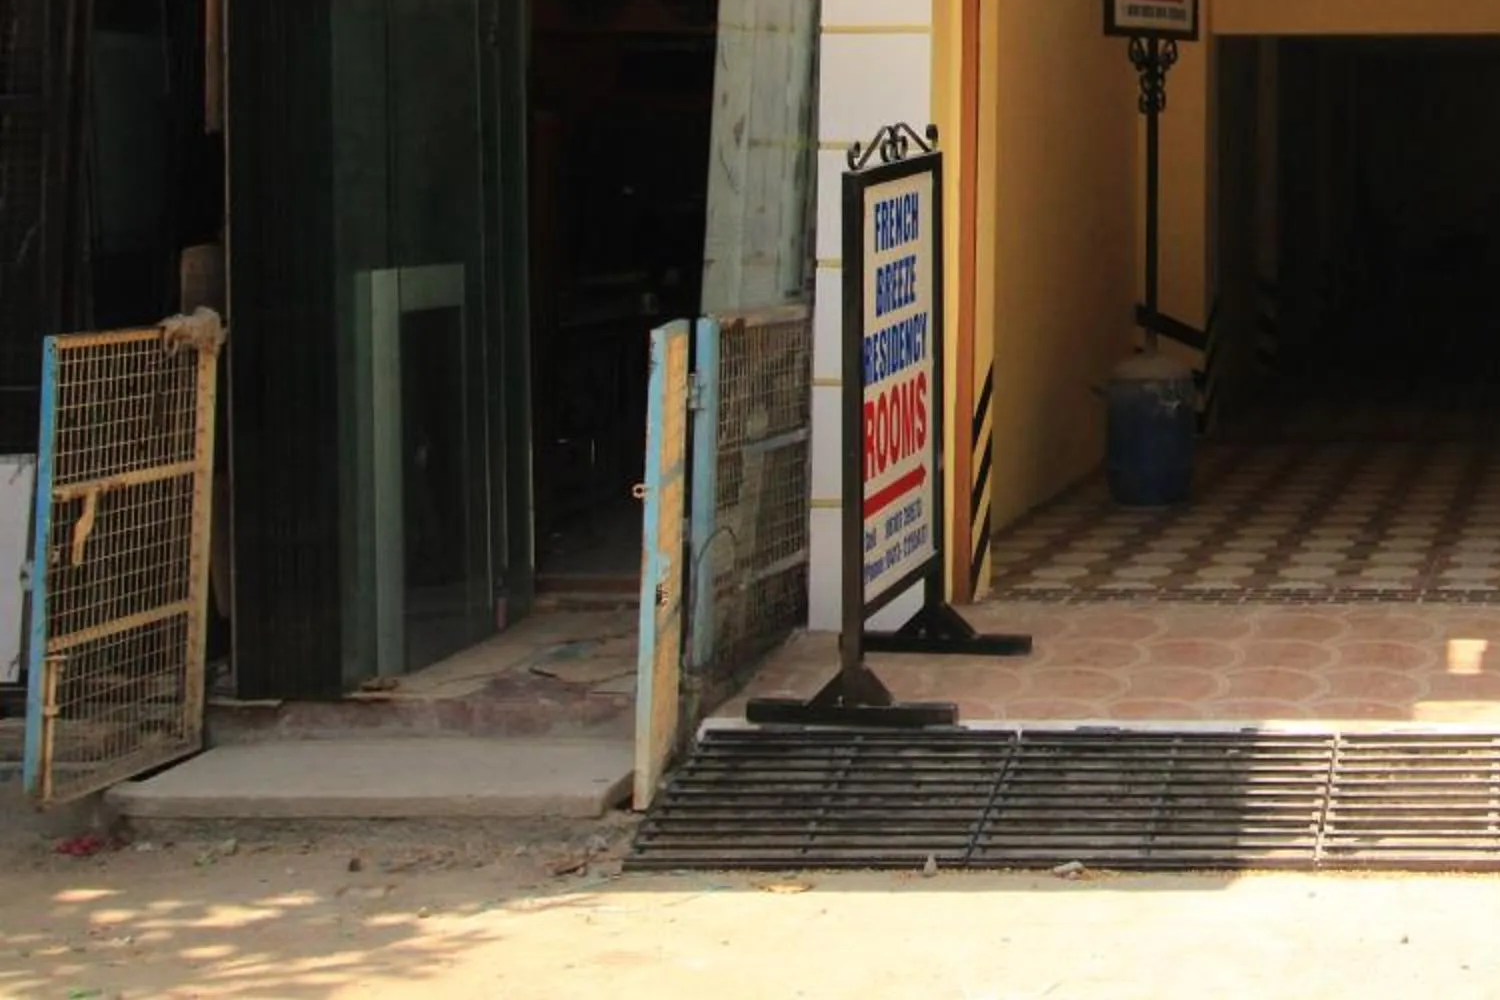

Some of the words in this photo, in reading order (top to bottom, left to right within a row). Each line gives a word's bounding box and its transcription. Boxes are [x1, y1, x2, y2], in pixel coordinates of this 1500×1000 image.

[875, 192, 919, 252] FRENCH
[876, 255, 916, 317] BREEZE
[864, 312, 927, 387] RESIDENCY
[864, 371, 927, 483] ROOMS
